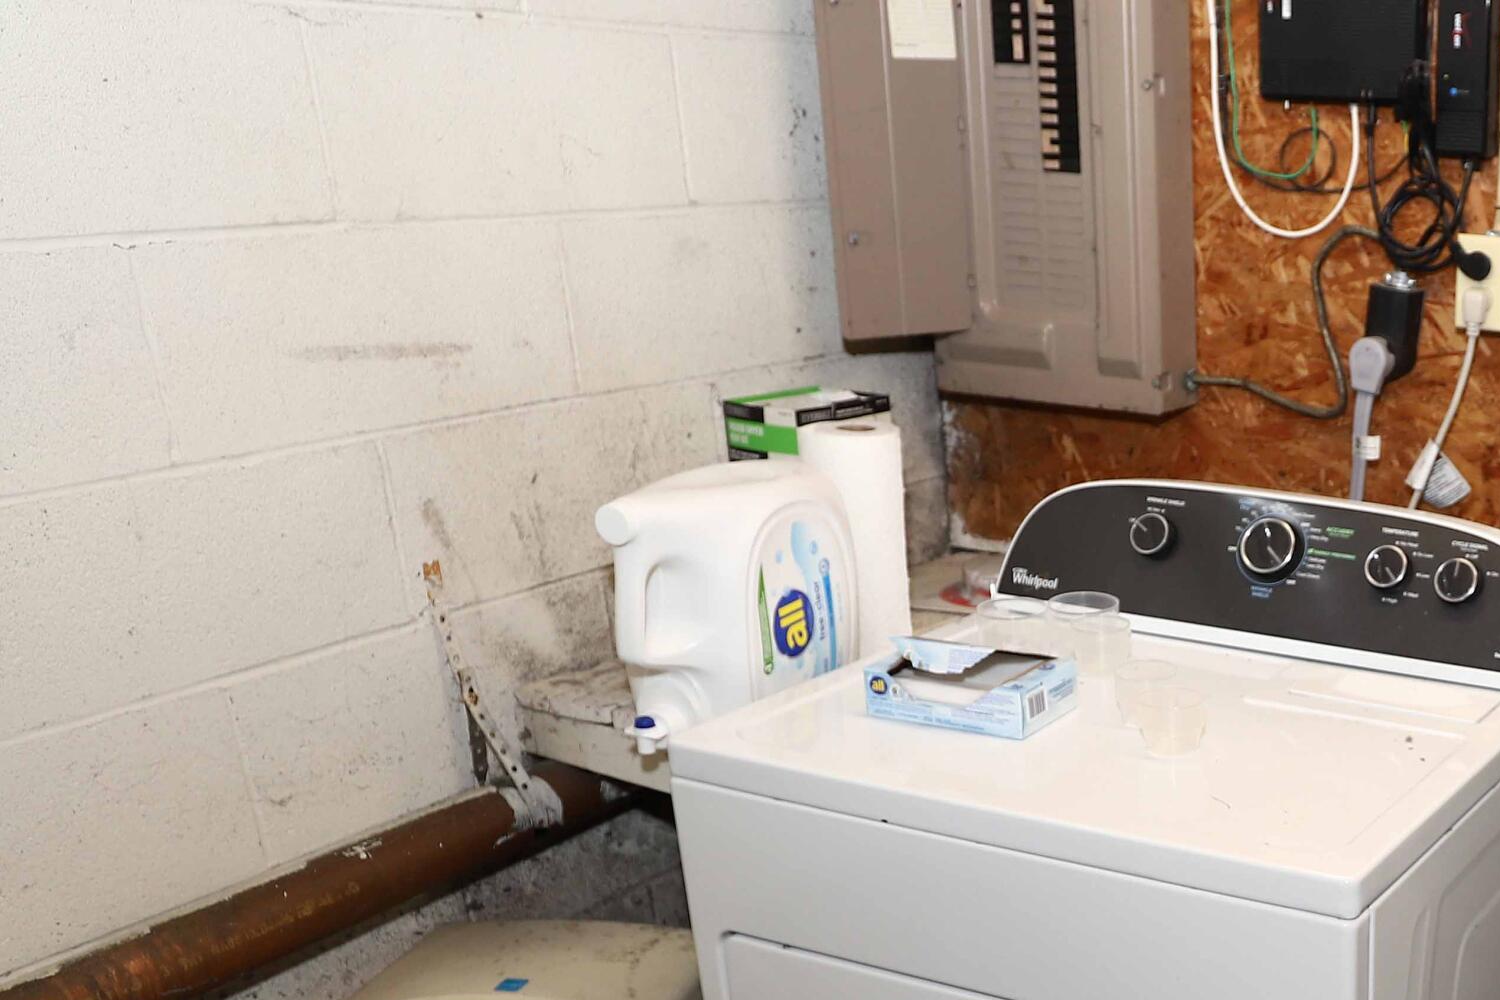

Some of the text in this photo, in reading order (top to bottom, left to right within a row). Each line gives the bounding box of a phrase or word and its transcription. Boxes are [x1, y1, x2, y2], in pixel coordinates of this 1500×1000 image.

[1012, 569, 1059, 590] Whirlpool
[777, 597, 809, 651] all
[870, 679, 886, 692] all
